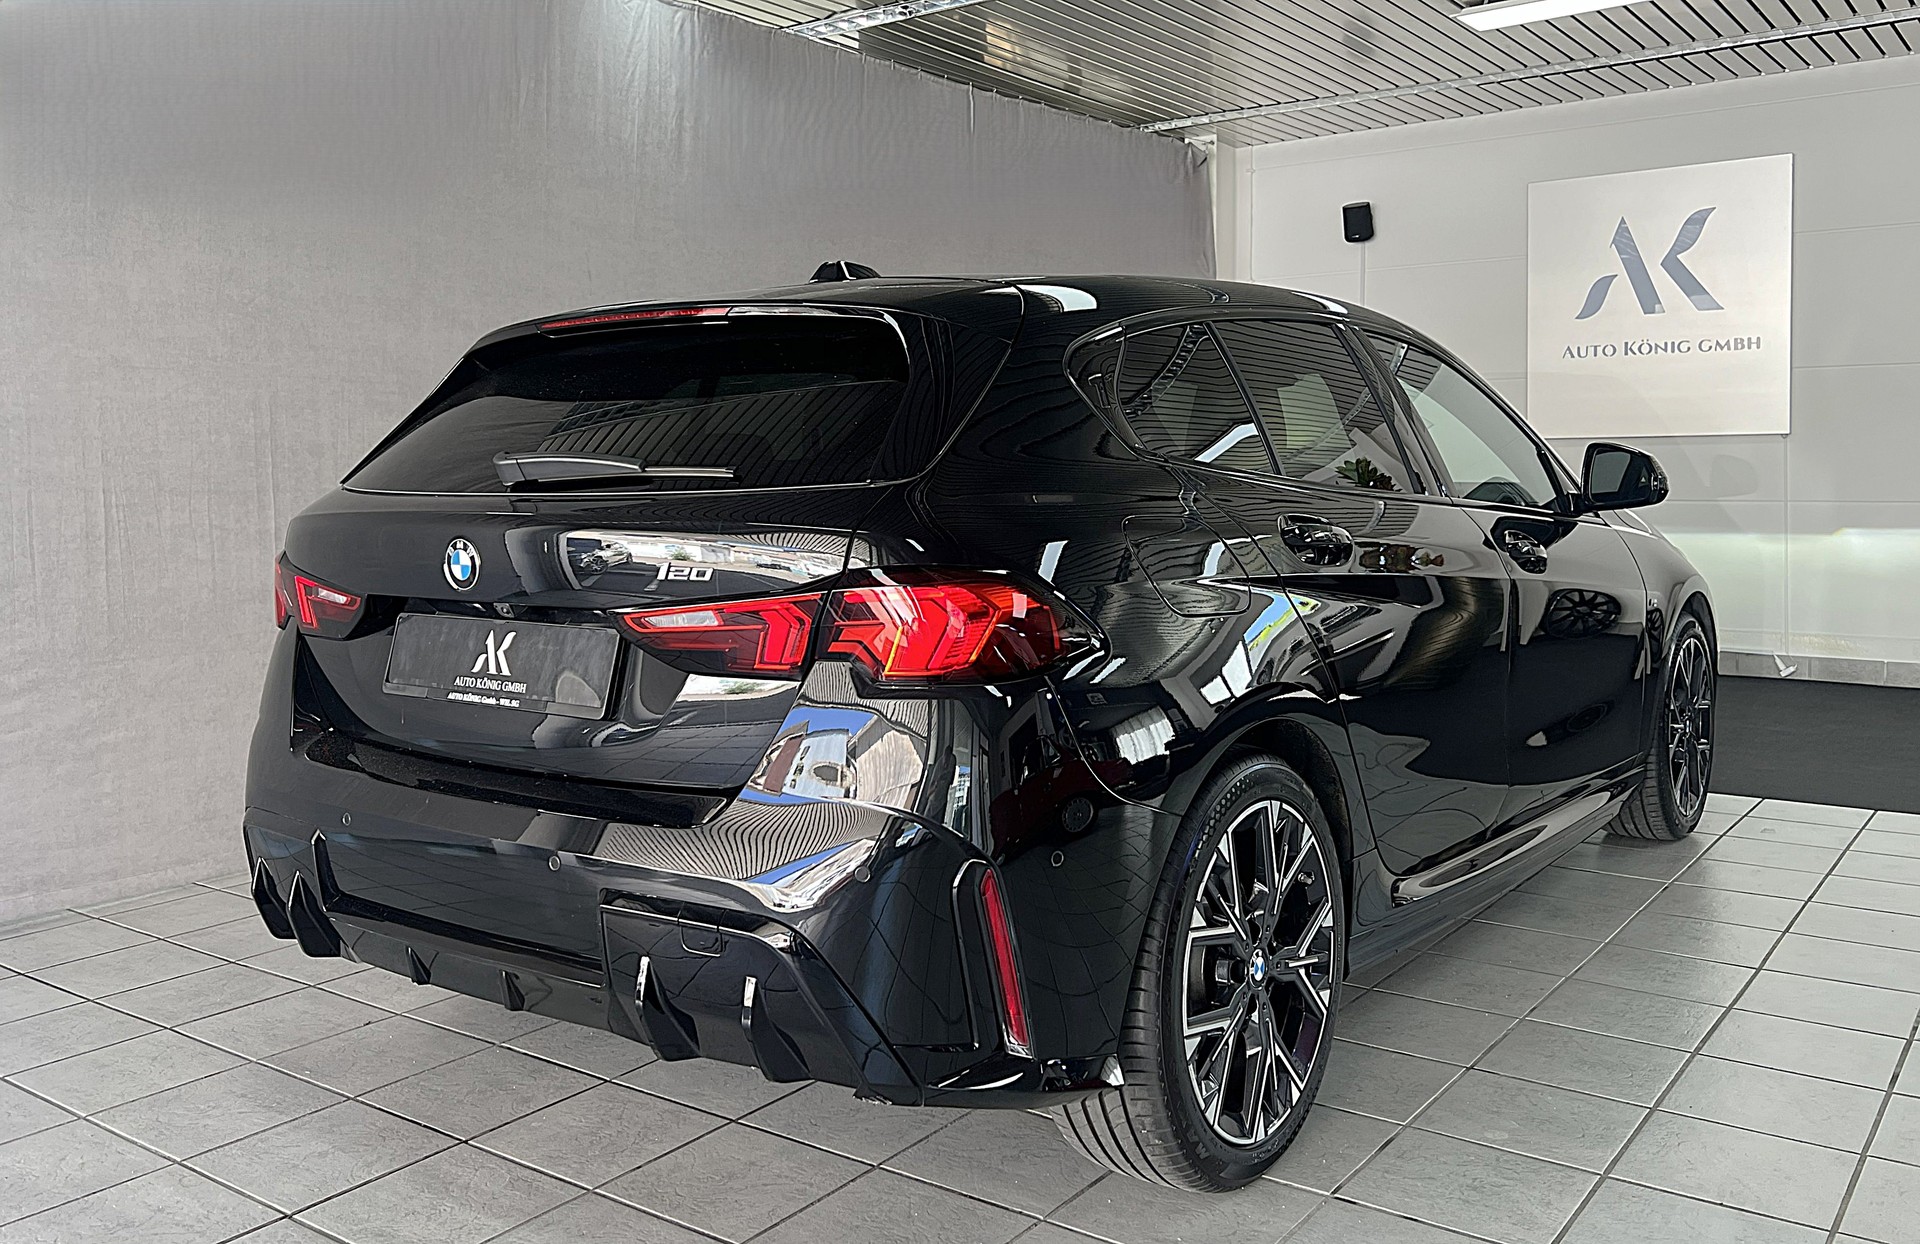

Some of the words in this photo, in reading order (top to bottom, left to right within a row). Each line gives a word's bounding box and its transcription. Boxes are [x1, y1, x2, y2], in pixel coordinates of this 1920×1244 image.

[1574, 206, 1725, 320] AK
[1562, 344, 1617, 359] AUTO
[1623, 339, 1691, 356] KÖNIG
[1698, 336, 1761, 353] GMBH
[656, 562, 714, 581] 120
[471, 630, 516, 676] AK
[454, 676, 476, 688] AUTO
[476, 677, 501, 690] KÖNIG
[502, 681, 527, 693] GMBH
[447, 692, 463, 700] AUTO
